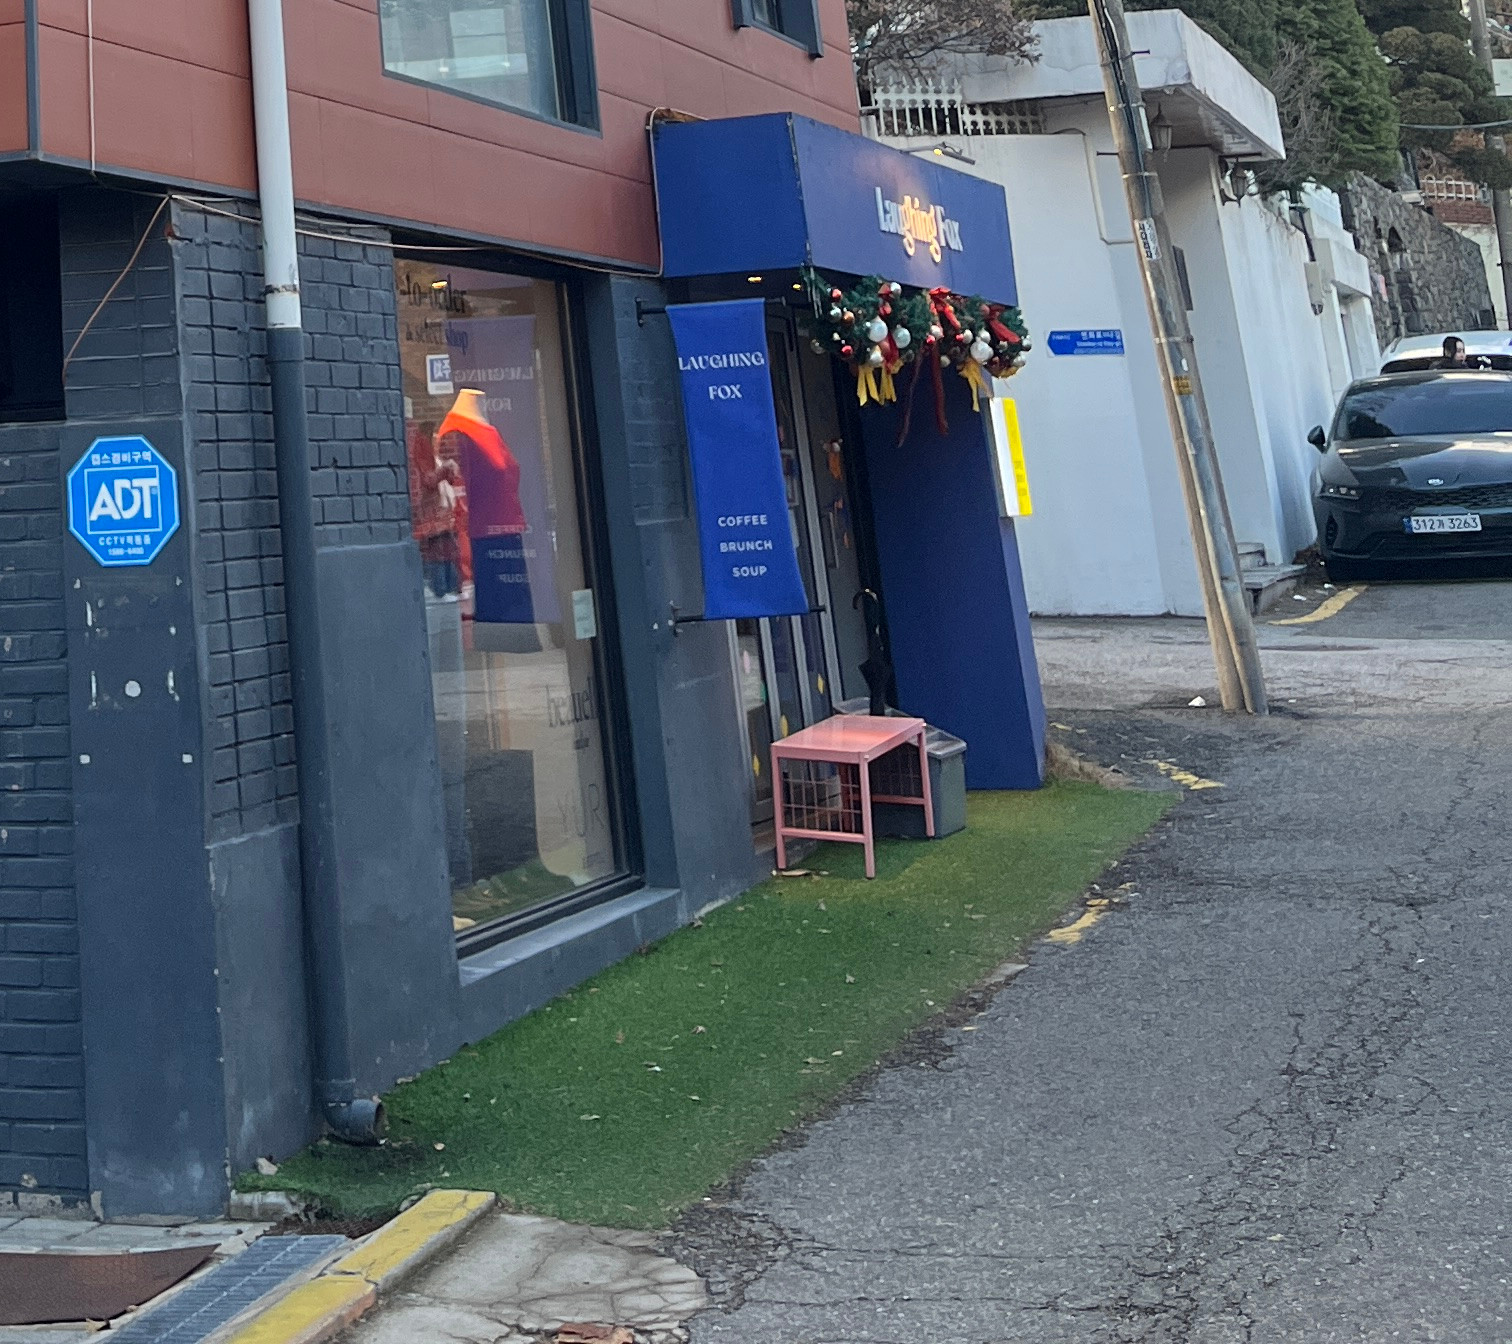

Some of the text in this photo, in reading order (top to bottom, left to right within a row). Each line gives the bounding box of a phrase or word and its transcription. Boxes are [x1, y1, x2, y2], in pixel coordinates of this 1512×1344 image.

[875, 186, 964, 264] Laughing Fox
[678, 352, 765, 371] LAUGHING
[708, 384, 743, 400] FOX
[89, 477, 160, 522] ADT
[717, 514, 768, 528] COFFEE
[1448, 517, 1479, 529] 3263
[719, 540, 773, 553] BRUNCH
[732, 565, 768, 578] SOUP
